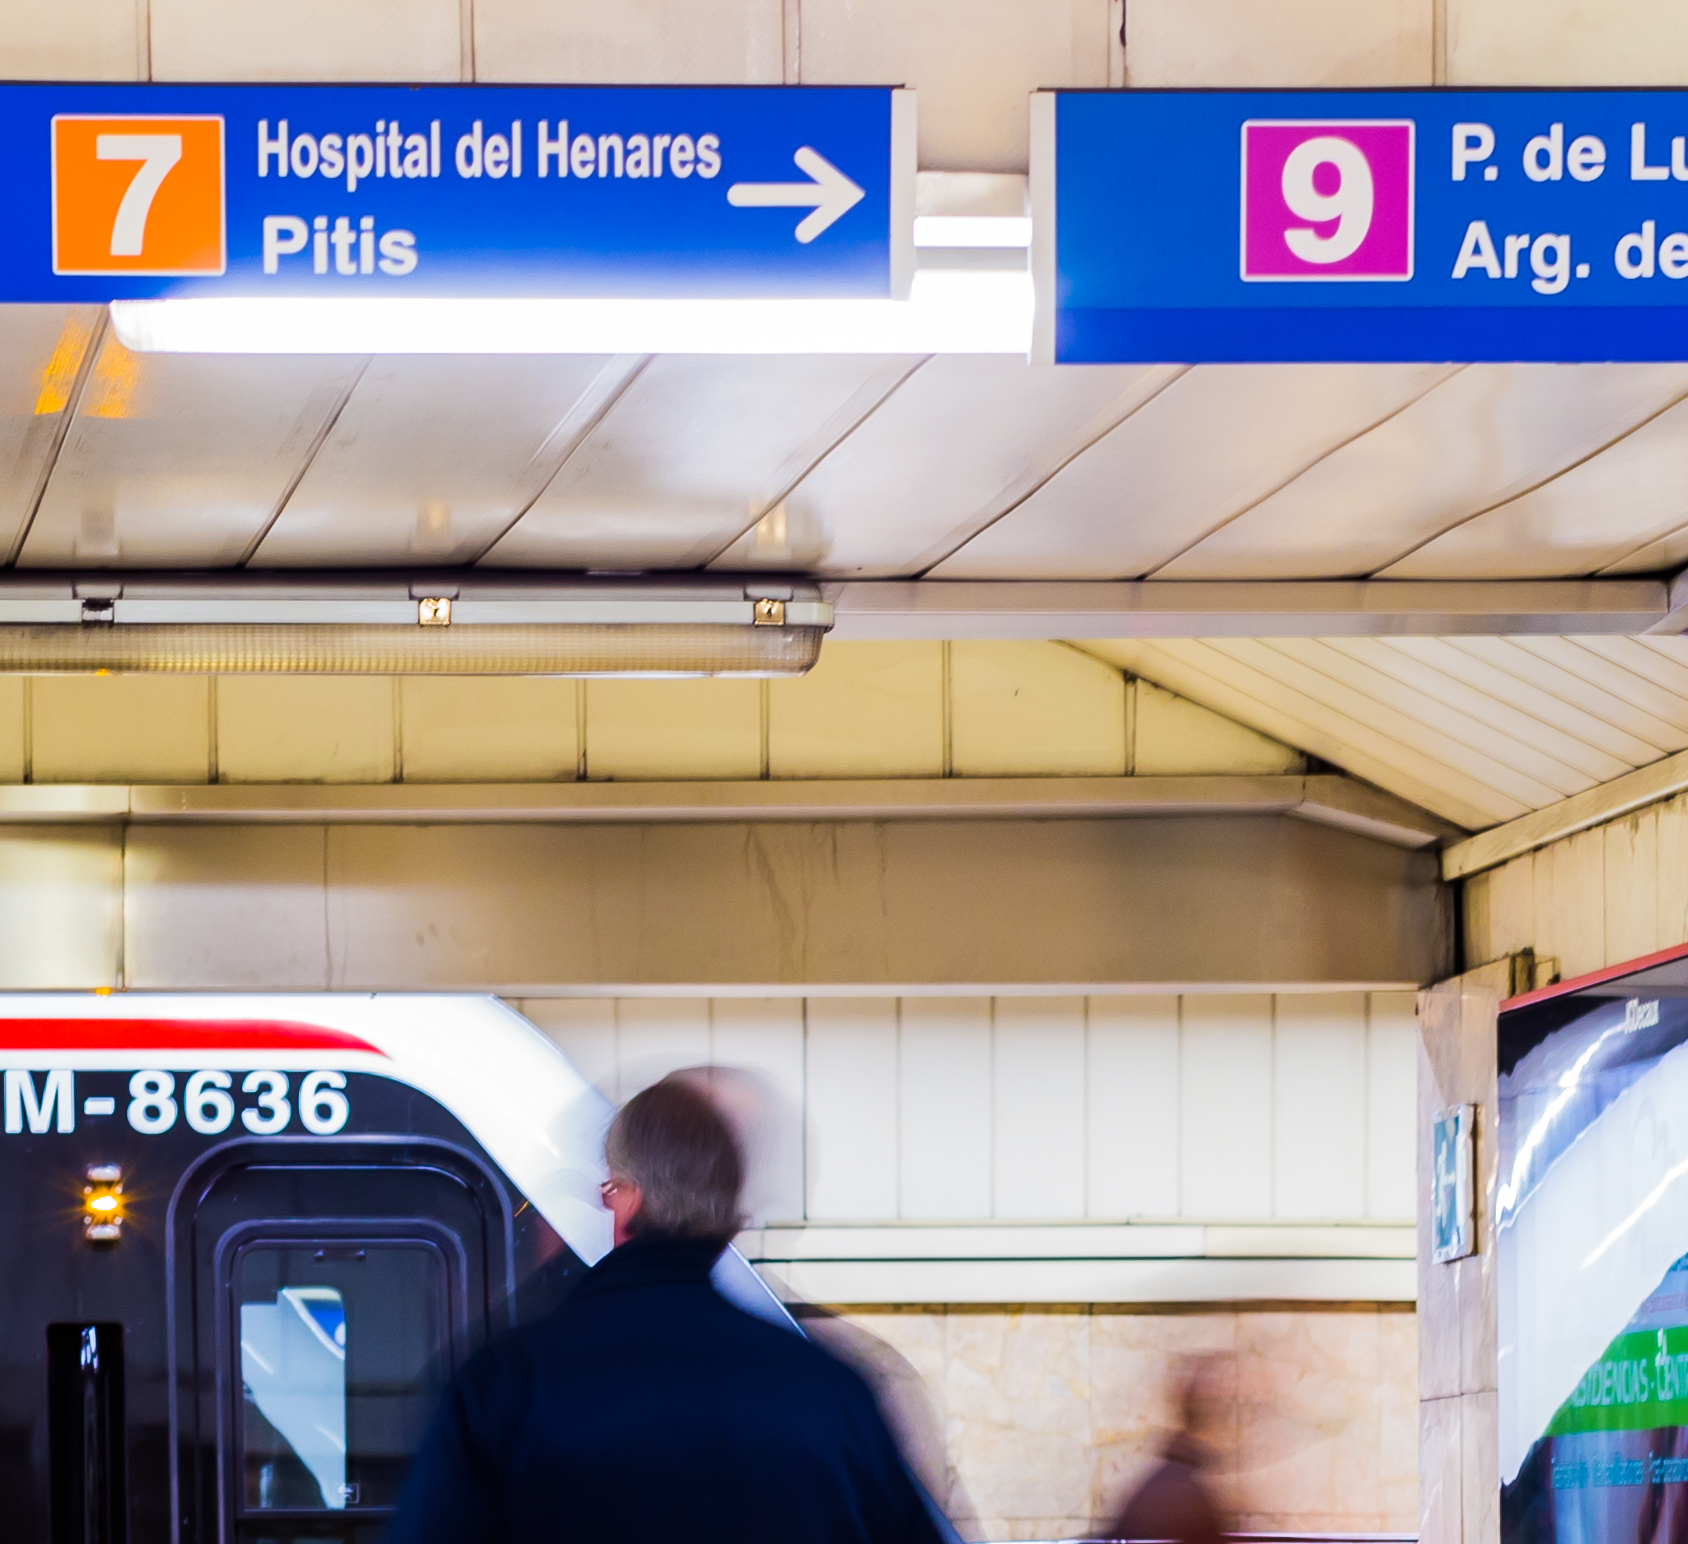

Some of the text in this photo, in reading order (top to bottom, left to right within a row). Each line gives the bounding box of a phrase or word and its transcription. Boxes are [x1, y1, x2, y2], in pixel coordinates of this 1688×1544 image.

[258, 119, 721, 192] Hospital del Henares
[1452, 123, 1498, 181] P.
[1523, 123, 1606, 182] de
[96, 135, 182, 256] 7
[1281, 137, 1374, 264] 9
[262, 215, 417, 276] Pitis
[1452, 221, 1590, 294] Arg.
[1624, 997, 1659, 1034] JCDecaux
[4, 1070, 350, 1134] M-8636
[1570, 1360, 1648, 1407] SIDENCIAS
